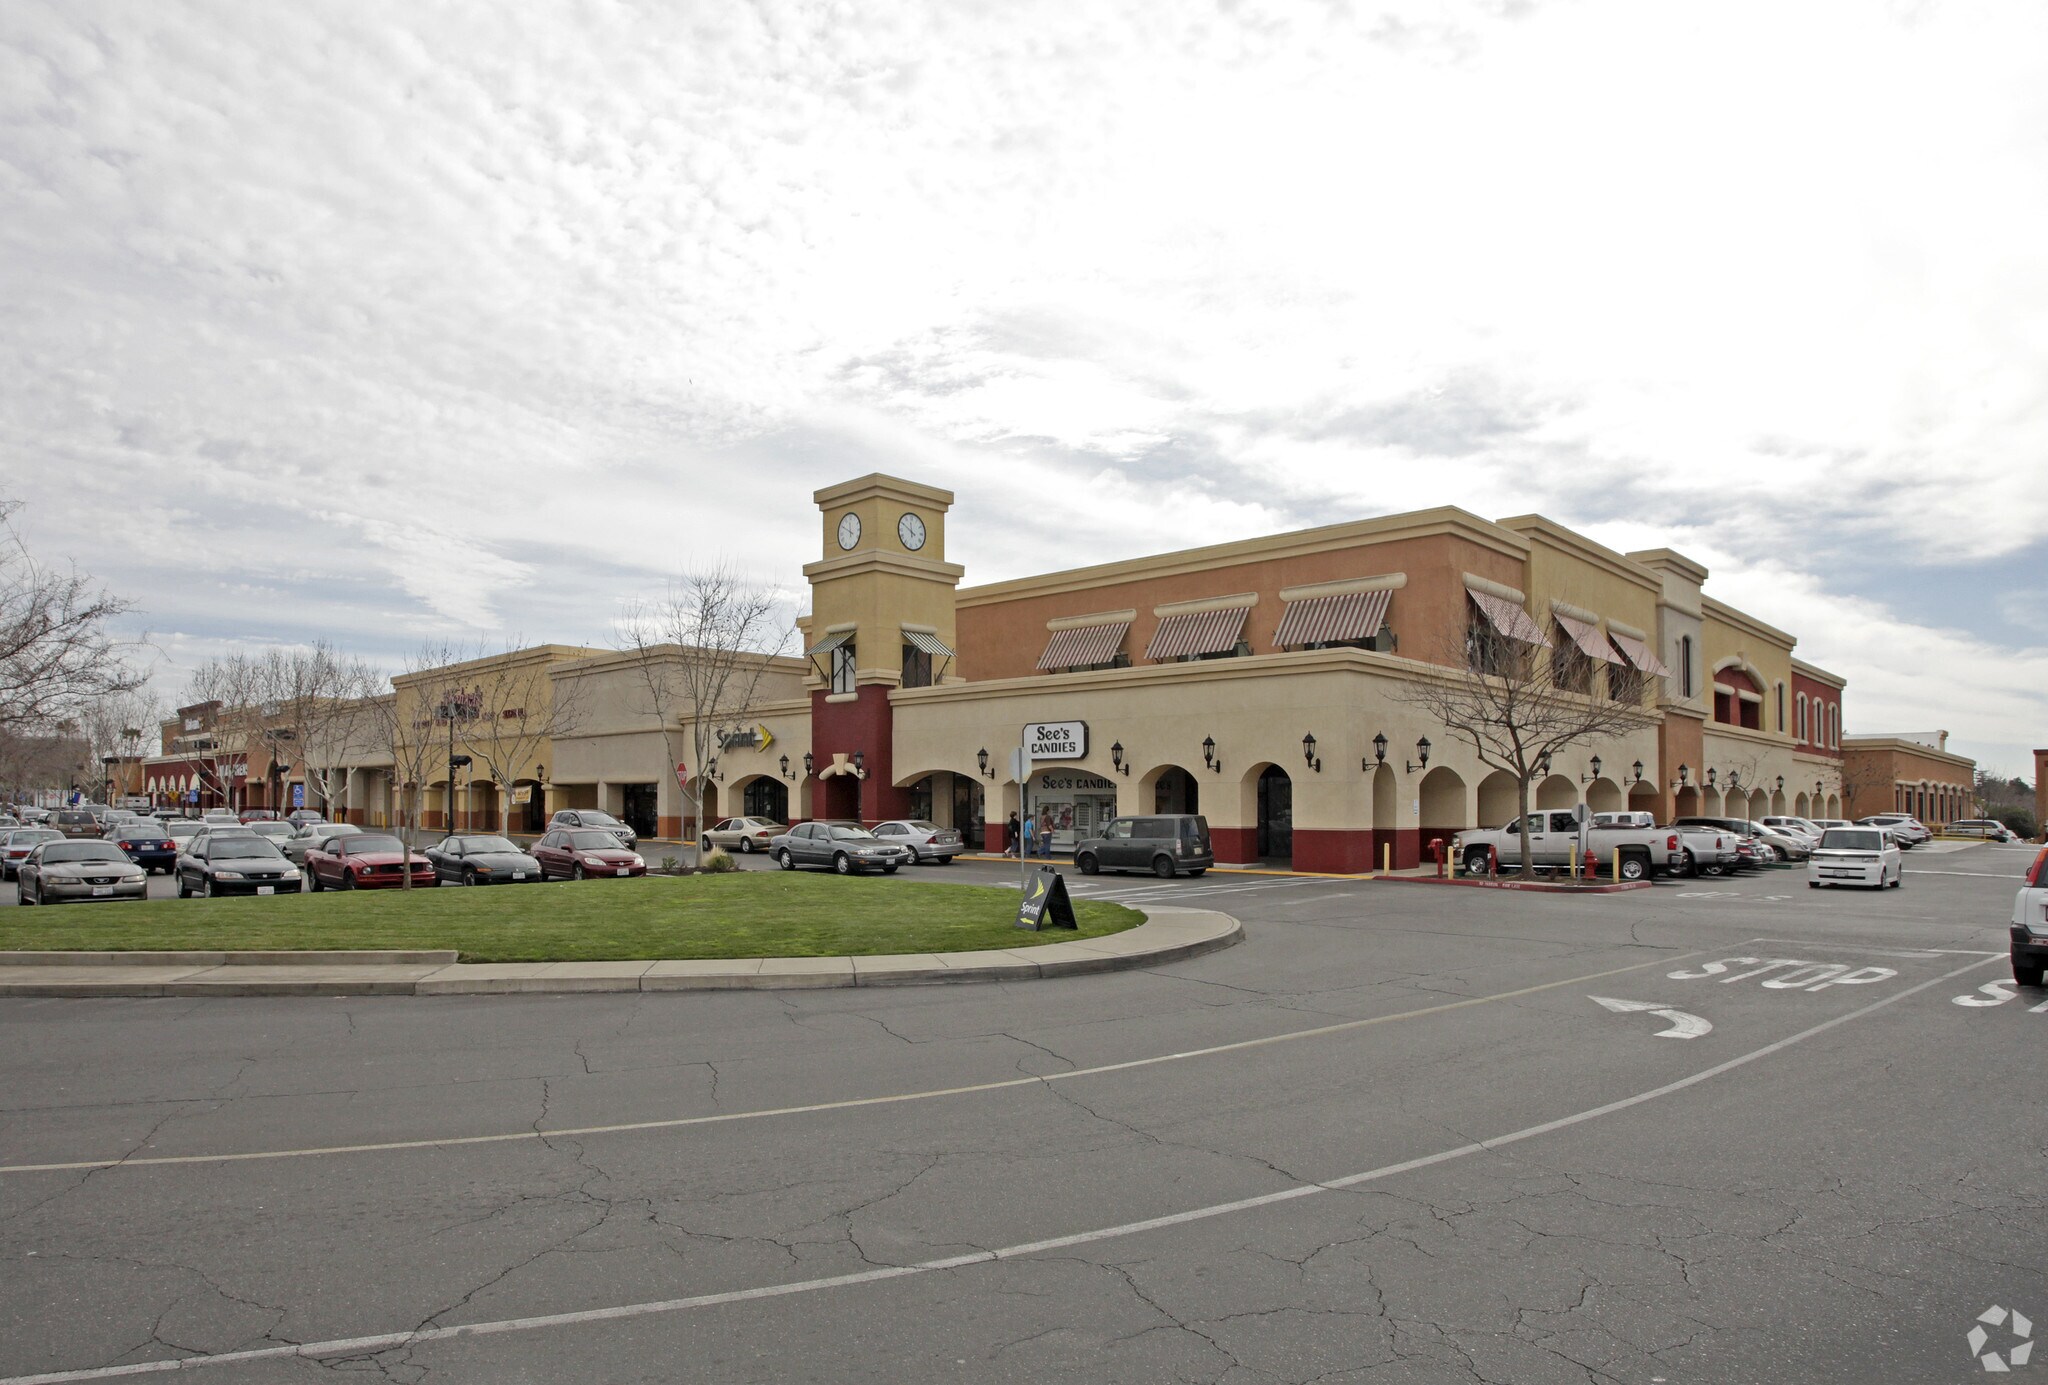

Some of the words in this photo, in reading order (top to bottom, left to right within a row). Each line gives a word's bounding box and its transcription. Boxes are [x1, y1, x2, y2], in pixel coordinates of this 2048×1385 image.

[1037, 726, 1070, 740] See's
[1031, 742, 1076, 753] CANDIES
[1042, 775, 1073, 789] See's
[1021, 902, 1040, 915] Sprint
[1666, 957, 1898, 991] STOP
